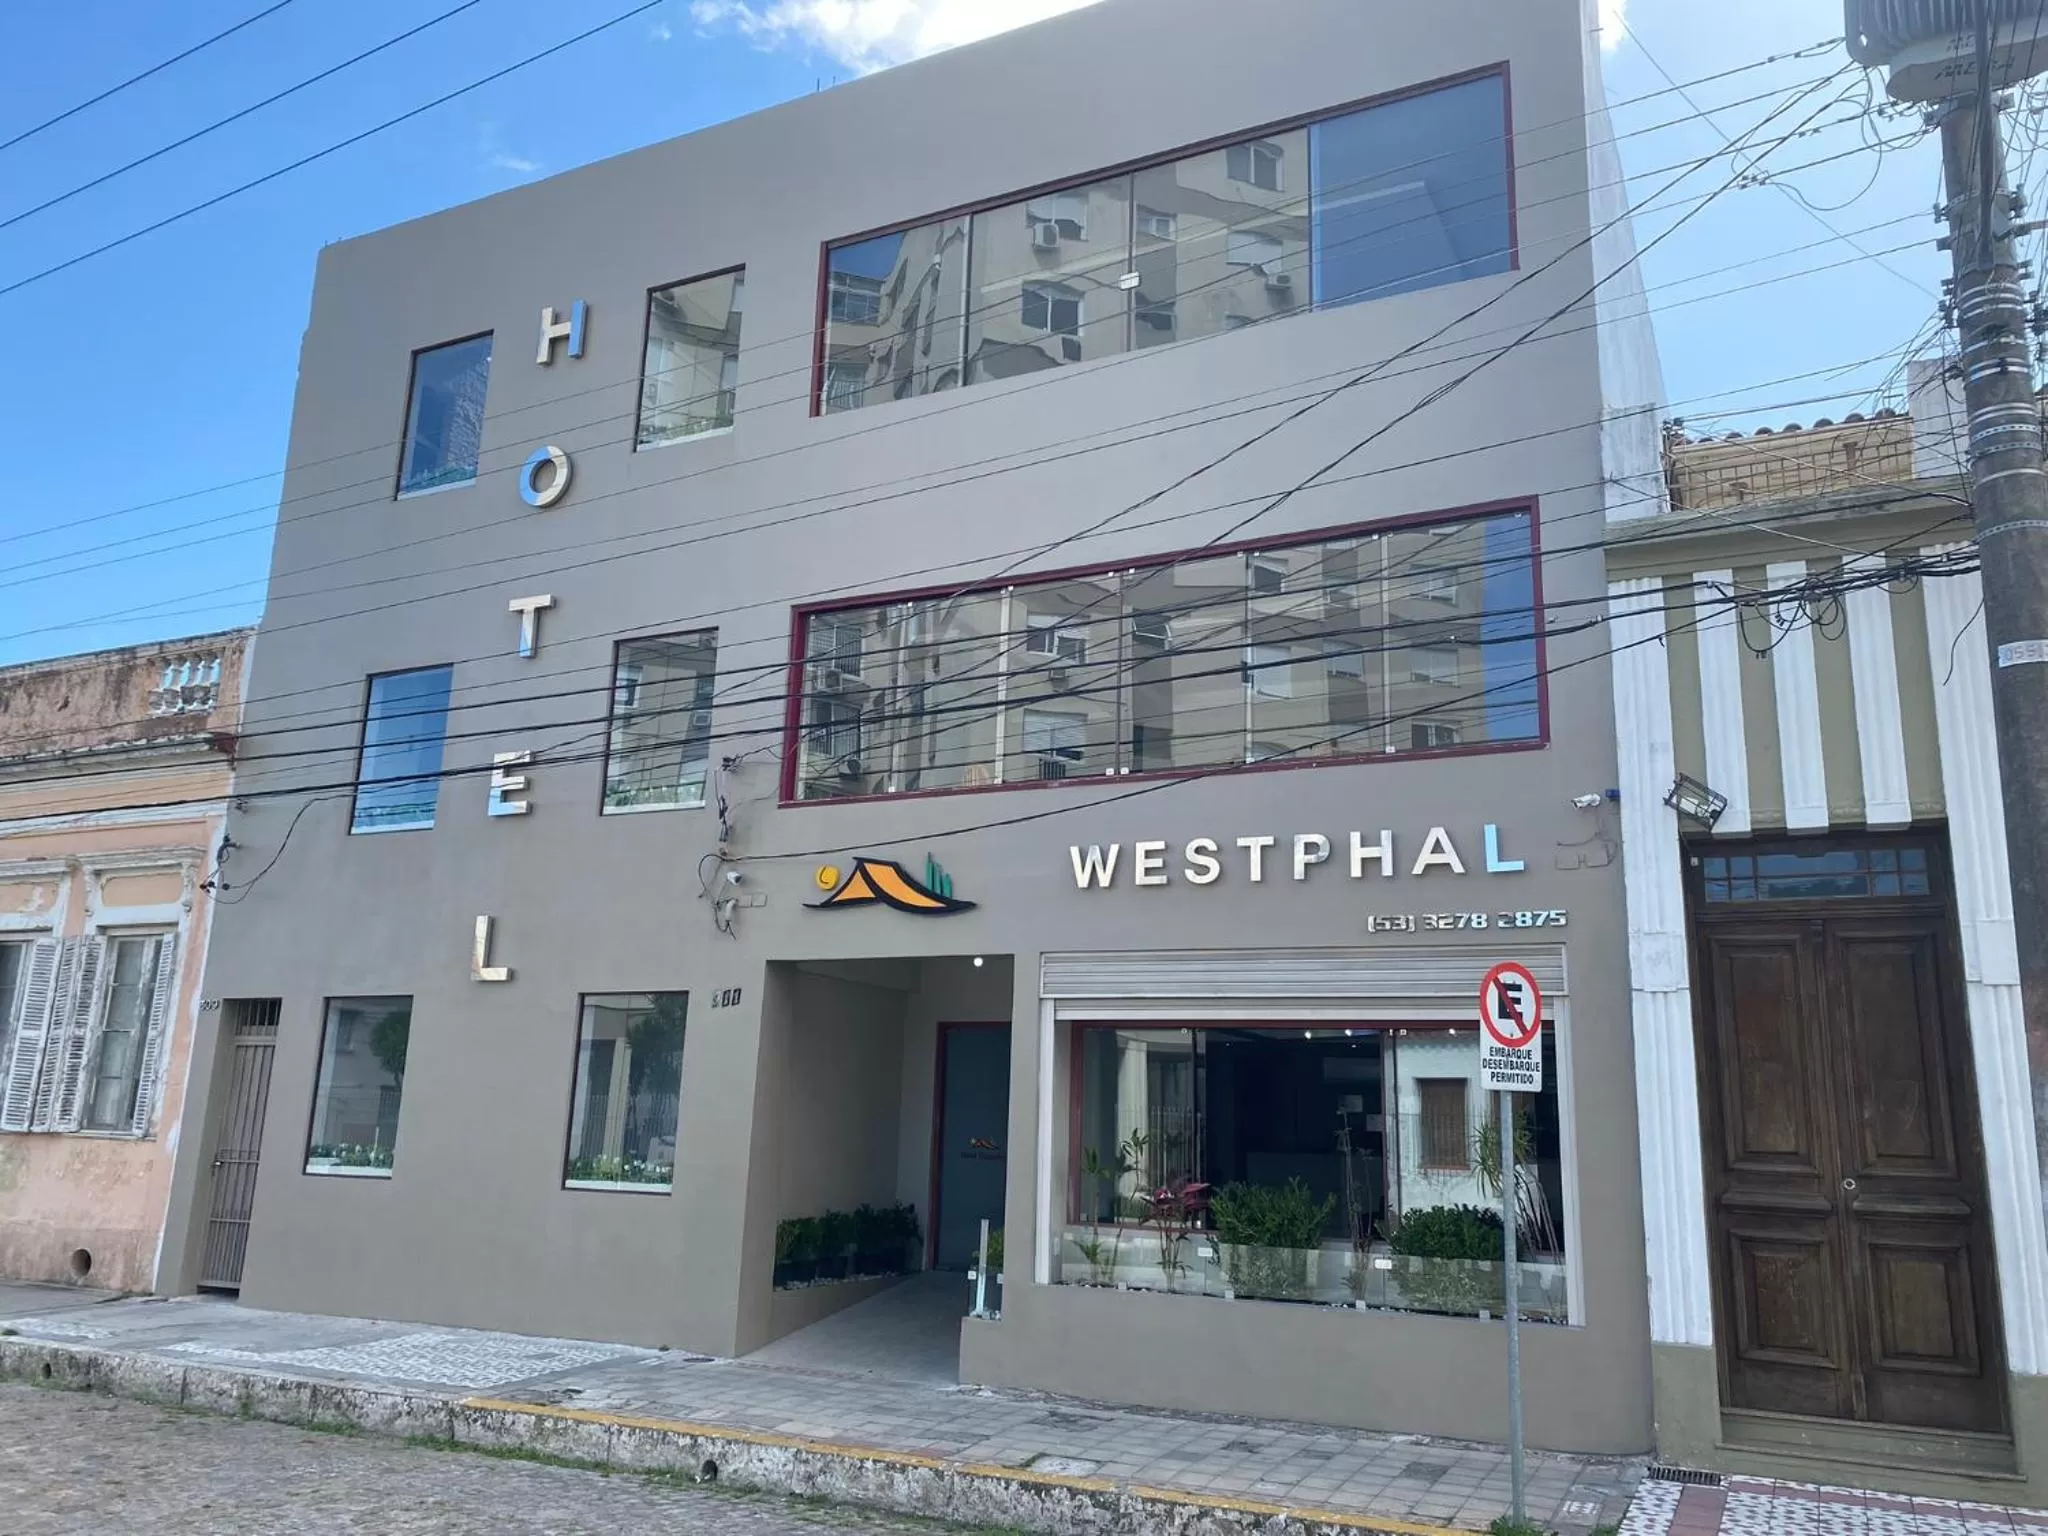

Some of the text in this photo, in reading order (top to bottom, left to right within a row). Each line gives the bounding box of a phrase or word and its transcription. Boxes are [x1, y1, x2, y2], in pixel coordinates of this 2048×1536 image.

[472, 299, 588, 982] HOTEL
[1069, 824, 1526, 888] WESTPHAL
[1368, 910, 1567, 932] (53) 3278 2875
[1490, 1047, 1533, 1060] EMBARQUE
[1482, 1058, 1541, 1072] DESEMBARQUE
[1490, 1072, 1534, 1084] PERMITIDO
